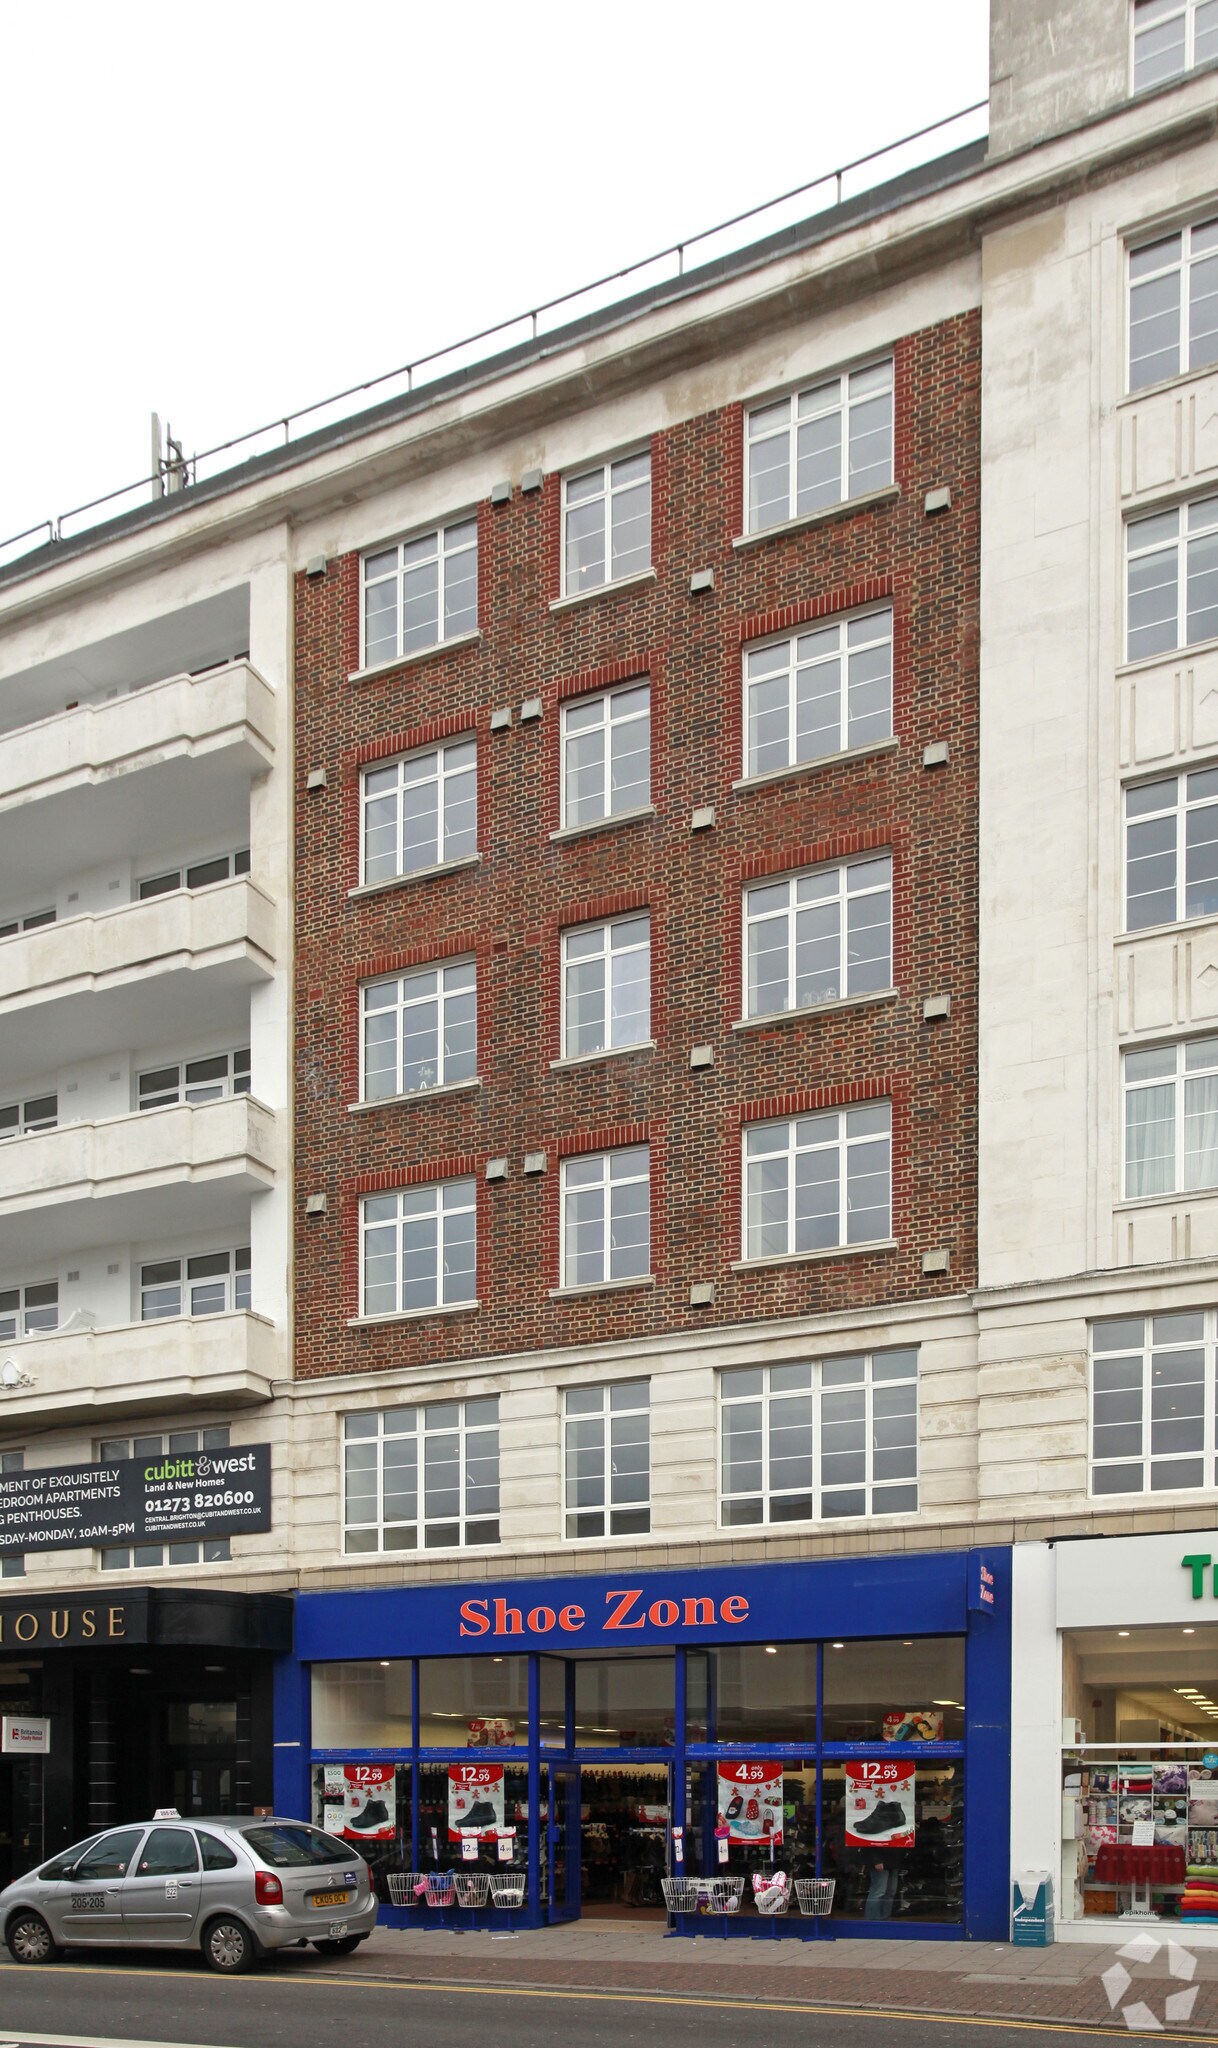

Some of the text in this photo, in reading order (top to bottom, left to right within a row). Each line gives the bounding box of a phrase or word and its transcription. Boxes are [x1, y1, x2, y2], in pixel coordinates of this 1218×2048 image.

[0, 1470, 120, 1493] MENT OF EXQUISITELY
[144, 1478, 225, 1493] Land & New Homes
[45, 1485, 121, 1504] APARTMENTS
[145, 1490, 254, 1513] 01273 820600
[7, 1506, 83, 1524] PENTHOUSES.
[79, 1522, 135, 1538] 10AM-5PM
[144, 1521, 206, 1532] CUBITTANDWEST.CO.UK
[459, 1589, 750, 1637] Shoe Zone
[0, 1607, 126, 1642] OUSE
